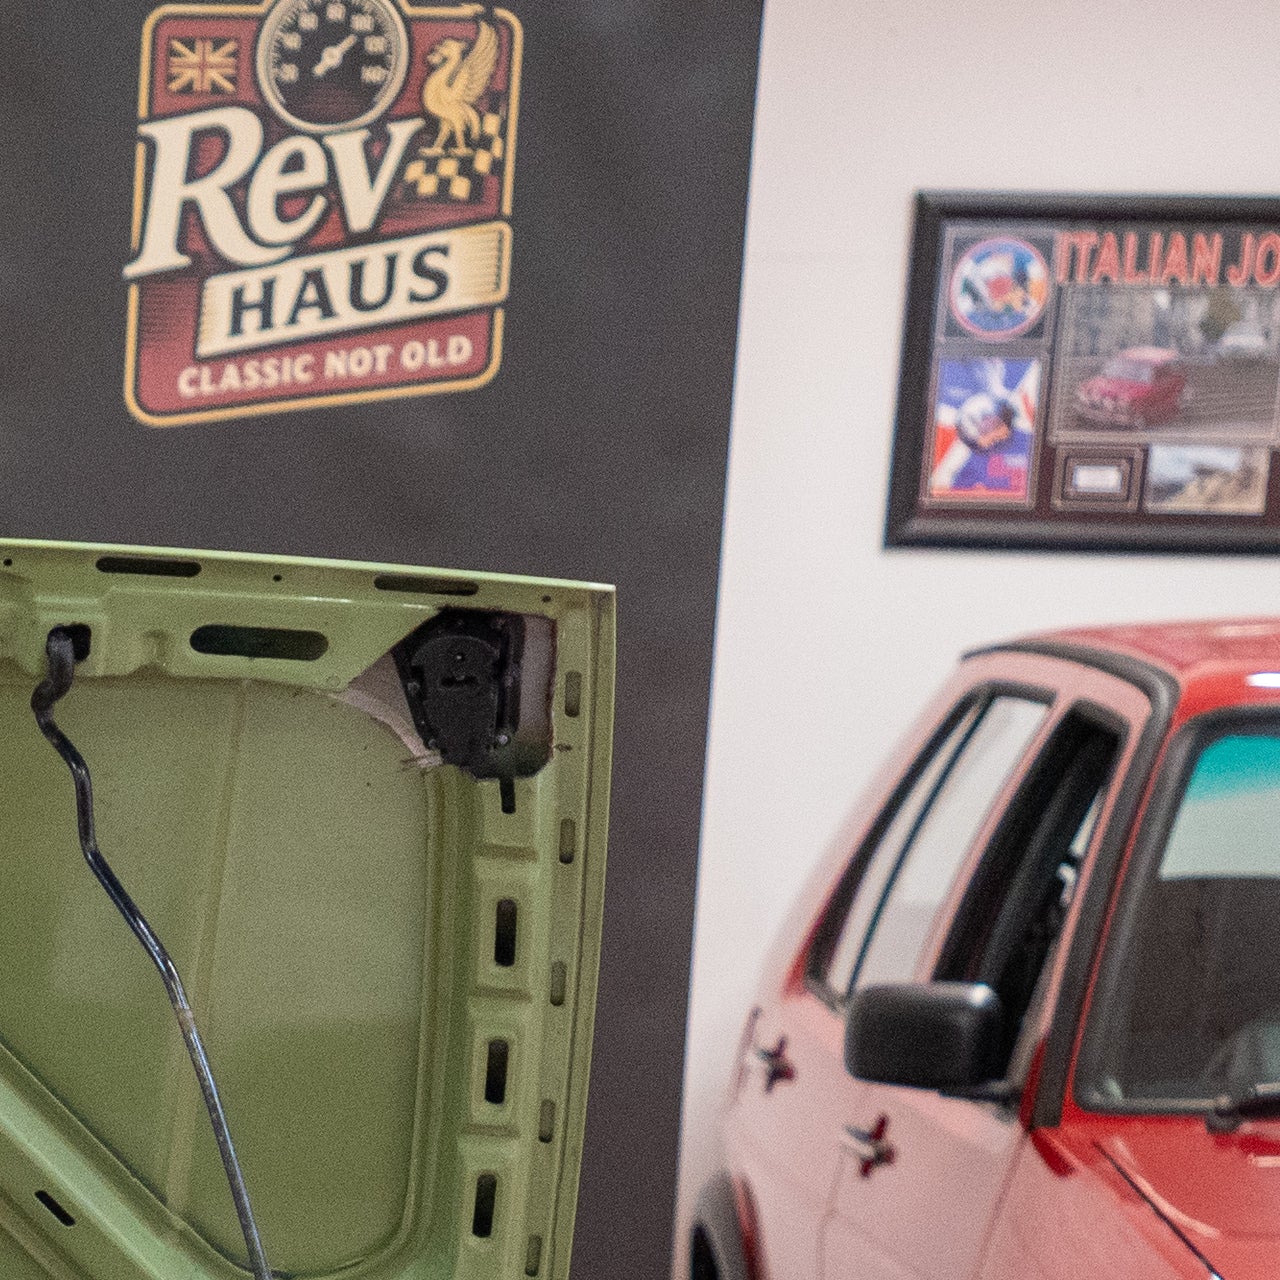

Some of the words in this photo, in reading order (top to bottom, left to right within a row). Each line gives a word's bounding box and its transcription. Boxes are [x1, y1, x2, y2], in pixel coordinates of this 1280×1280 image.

[123, 106, 425, 278] Rev
[229, 243, 451, 337] HAUS
[1055, 231, 1222, 285] ITALIAN
[178, 353, 315, 398] CLASSIC
[324, 344, 395, 379] NOT
[400, 335, 473, 371] OLD
